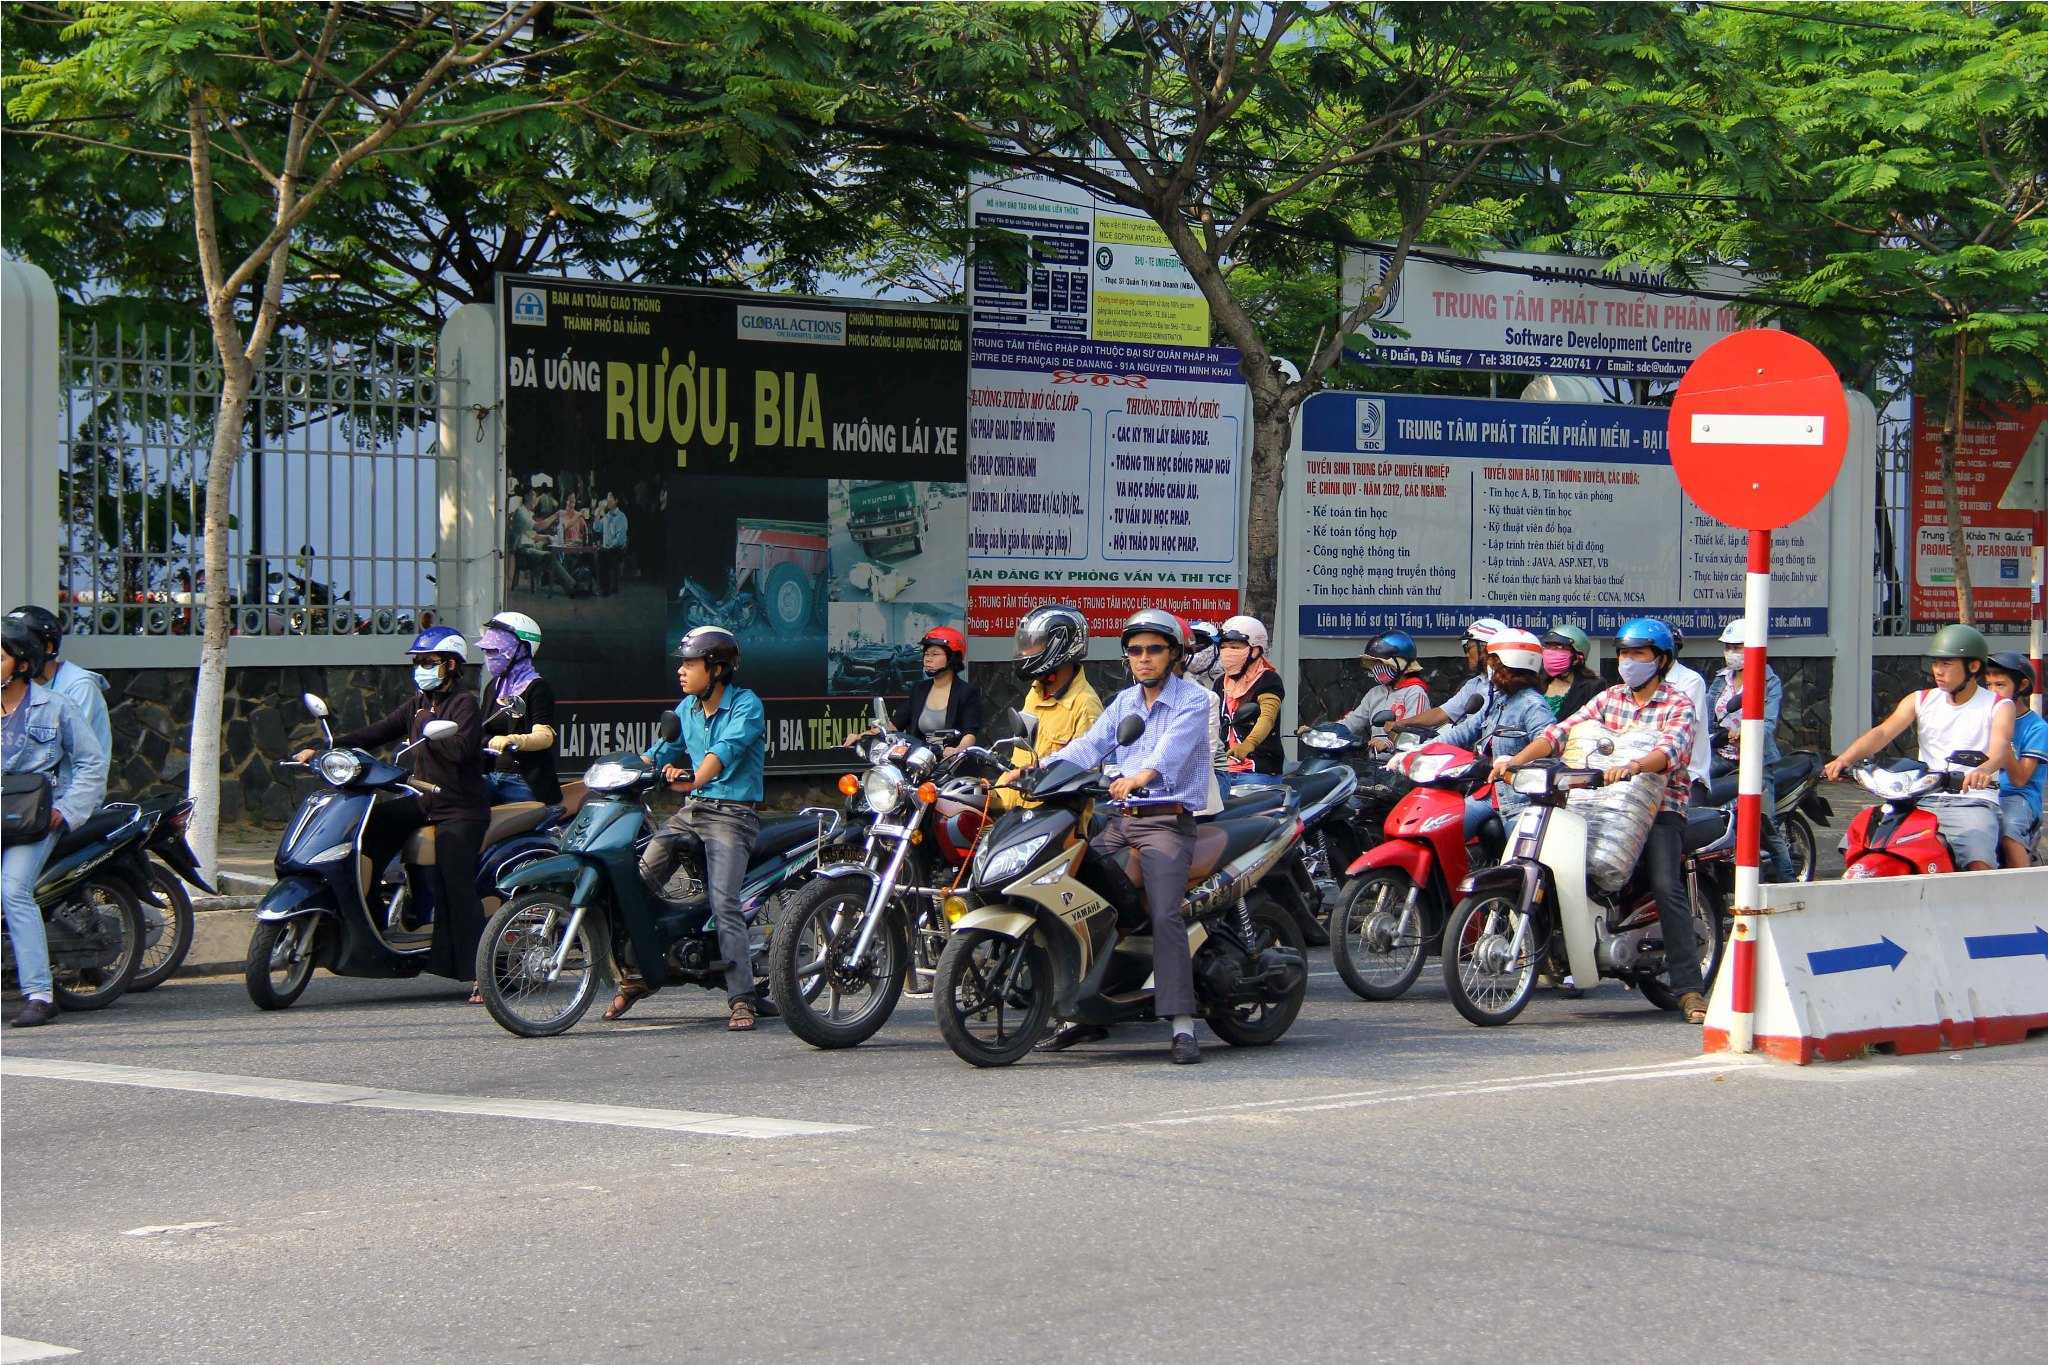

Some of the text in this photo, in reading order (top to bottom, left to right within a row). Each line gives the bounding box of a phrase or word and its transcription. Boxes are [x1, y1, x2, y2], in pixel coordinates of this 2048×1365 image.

[552, 291, 661, 312] BAN AN TOÀN GIAO THÔNG
[1433, 289, 1711, 331] TRUNG TÂM PHÁT TRIỂN PHẦN
[563, 314, 592, 331] THÀNH
[742, 316, 842, 334] GLOBAL ACTIONS
[1505, 327, 1692, 353] Software Development Centre
[973, 338, 1003, 348] TRUNG
[1006, 339, 1025, 350] TÂM
[1080, 345, 1093, 355] ĐN
[1126, 348, 1141, 359] ĐẠI
[1207, 354, 1219, 362] HN
[1002, 354, 1014, 363] DE
[1015, 356, 1060, 368] FRANÇAIS
[1063, 359, 1074, 367] DE
[1077, 359, 1113, 370] DANANG
[1120, 362, 1135, 371] 91A
[1137, 363, 1172, 373] NGUYEN
[1174, 366, 1187, 374] THI
[1189, 367, 1209, 375] MINH
[1212, 368, 1232, 377] KHAI
[1421, 350, 1433, 362] Đà
[1480, 353, 1496, 366] Tel:
[1500, 354, 1541, 367] 3810425
[1550, 357, 1591, 370] 2240741
[1607, 360, 1634, 372] Email:
[1636, 363, 1687, 374] sdc@udn.vn
[510, 347, 958, 468] ĐÃ UỐNG RƯỢU, BIA KHÔNG LÁI XE
[1397, 415, 1663, 453] TRUNG TÂM PHÁT TRIỂN PHẦN MỀM ĐẠI
[1364, 441, 1380, 450] SDC
[1307, 457, 1331, 475] TUYỂN
[1334, 462, 1350, 475] SINH
[1353, 462, 1376, 476] TRUNG
[1394, 462, 1422, 478] CHUYÊN
[1425, 465, 1450, 481] NGHIỆP
[1307, 478, 1317, 497] HỆ
[1320, 479, 1340, 495] CHÍNH
[1342, 482, 1357, 496] QUY
[1383, 483, 1402, 498] 2012,
[1489, 486, 1502, 497] Tin
[1505, 487, 1519, 499] học
[1543, 488, 1556, 499] Tin
[1558, 489, 1572, 501] học
[1142, 508, 1152, 524] DU
[1154, 509, 1168, 529] HỌC
[1313, 504, 1387, 520] Kế toán tin học
[1313, 524, 1327, 537] Kế
[1330, 525, 1351, 537] toán
[1380, 527, 1397, 539] hợp
[1921, 531, 1945, 541] Trung
[1988, 532, 2000, 540] Thi
[1313, 545, 1410, 559] Công nghệ thông tin
[1807, 554, 1815, 564] tin
[1977, 545, 2018, 557] PEARSON
[1313, 564, 1338, 578] Công
[1342, 565, 1364, 579] nghệ
[1368, 566, 1394, 579] mạng
[1429, 566, 1456, 579] thông
[1598, 558, 1609, 568] VB
[1181, 573, 1203, 583] THI
[1208, 574, 1232, 583] TCF
[1313, 584, 1328, 595] Tin
[1332, 584, 1349, 597] học
[1352, 584, 1375, 595] hành
[1379, 584, 1403, 596] chính
[1407, 585, 1423, 596] văn
[1624, 592, 1645, 602] MCSA
[1694, 589, 1714, 599] CNTT
[1775, 615, 1811, 628] sdc.udn.vn
[559, 714, 586, 757] LÁI
[590, 722, 611, 756] XE
[616, 720, 647, 753] SAU
[780, 723, 804, 752] BIA
[808, 704, 843, 749] TIỀN
[1071, 901, 1101, 921] YAMAHA
